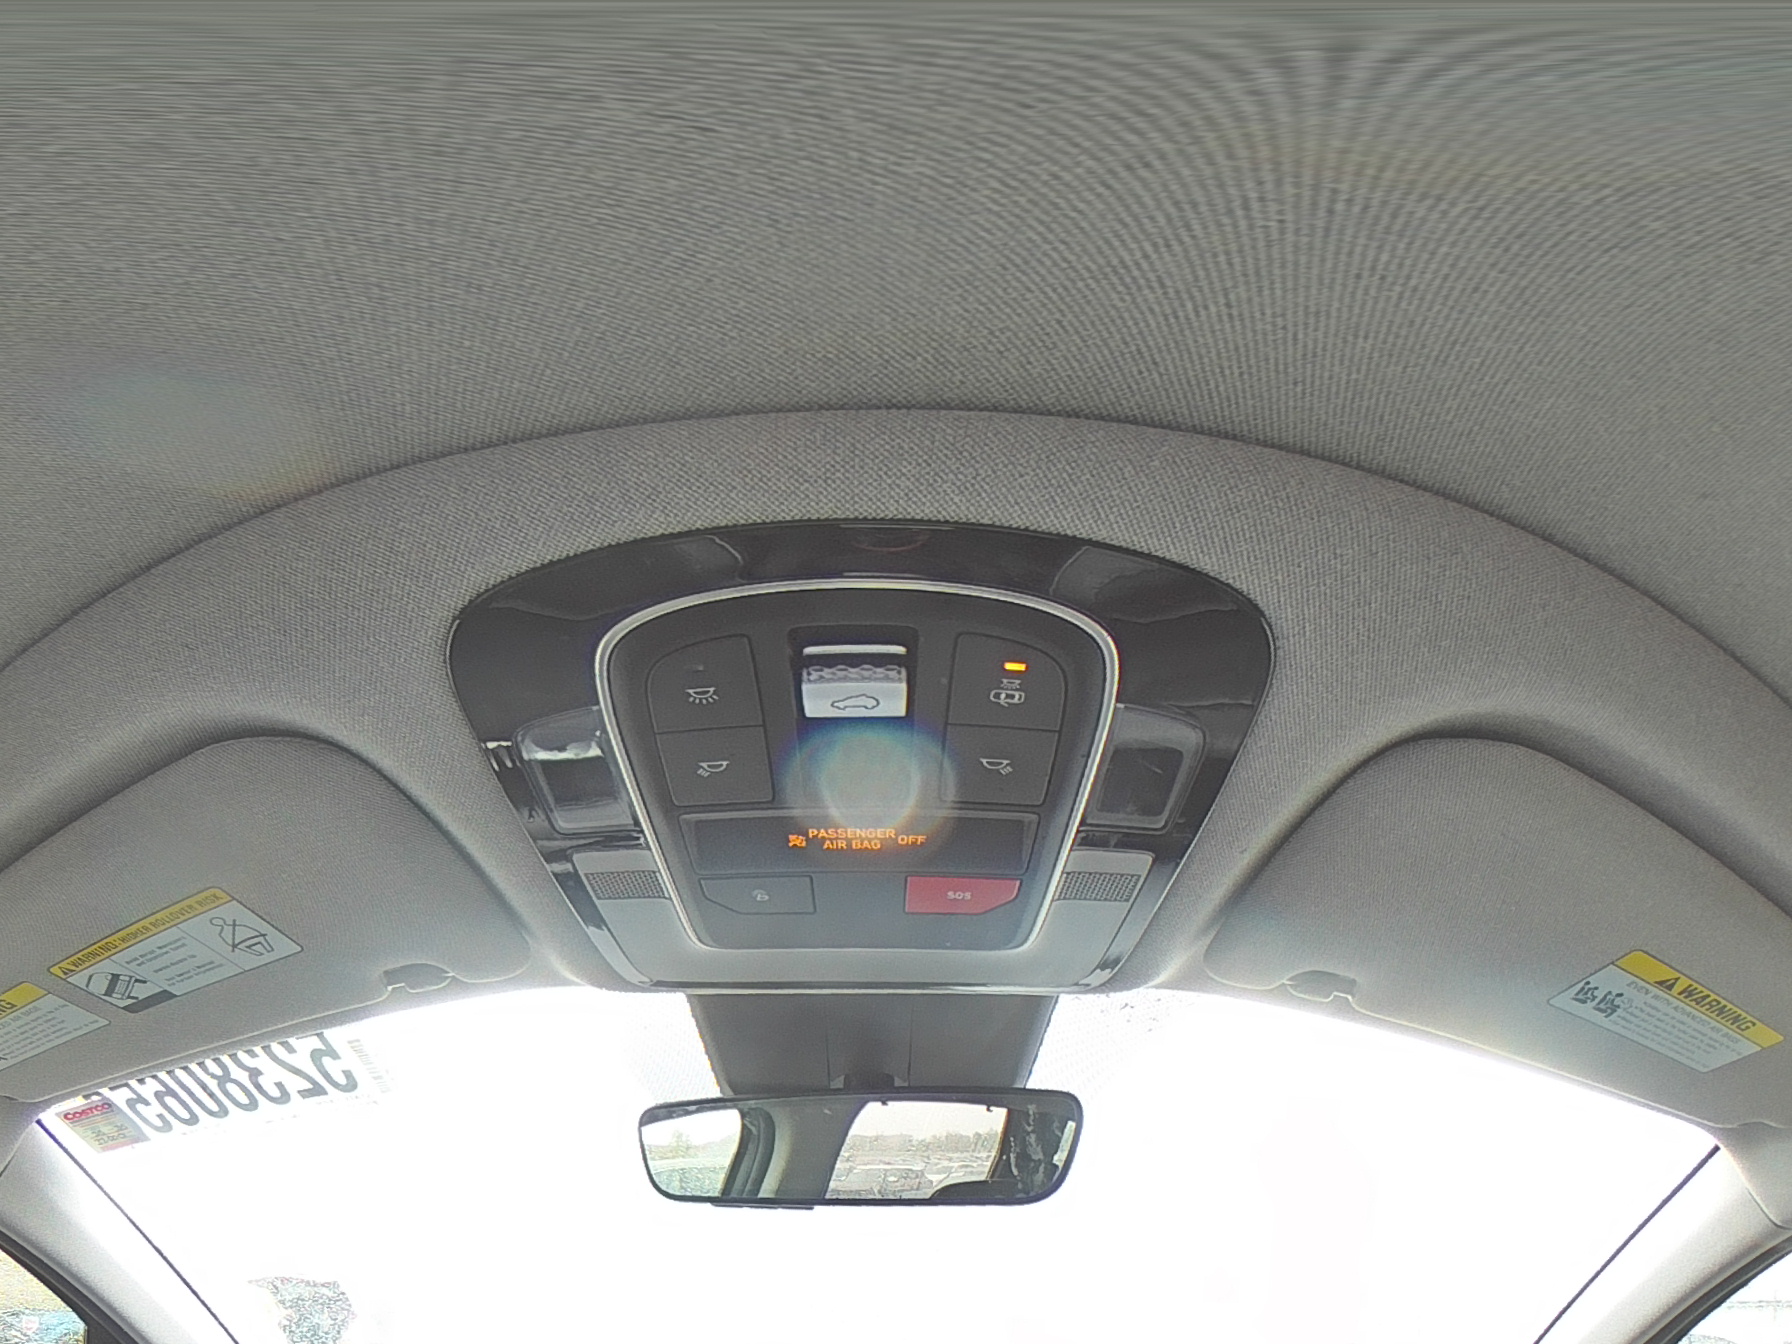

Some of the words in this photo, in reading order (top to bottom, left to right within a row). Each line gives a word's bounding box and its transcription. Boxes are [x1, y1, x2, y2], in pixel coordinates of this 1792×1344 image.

[808, 828, 896, 839] PASSENGER
[822, 839, 847, 850] AIR
[851, 839, 882, 850] BAG
[897, 835, 927, 845] OFF
[946, 890, 972, 900] SOS
[150, 903, 196, 929] ROLLOVER
[197, 892, 224, 912] RISK
[1676, 983, 1757, 1032] WARNING
[63, 1102, 113, 1121] COSTCO
